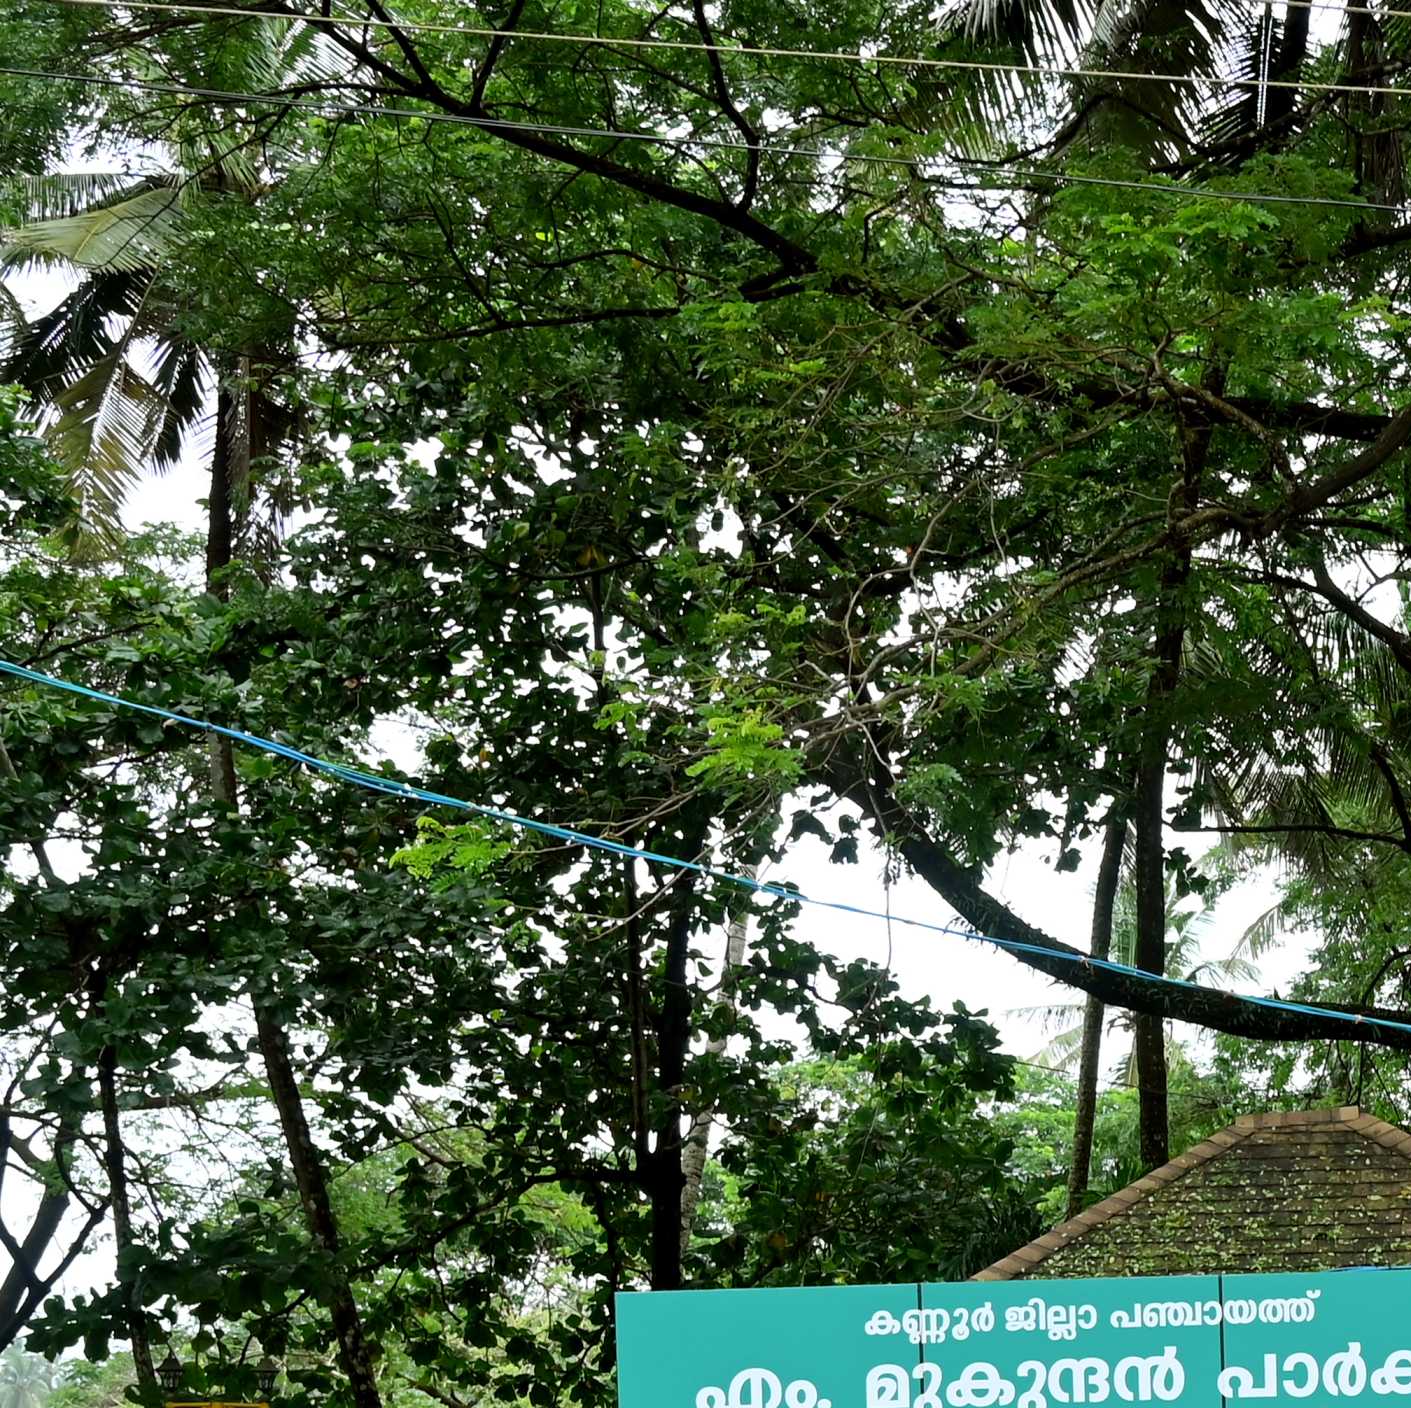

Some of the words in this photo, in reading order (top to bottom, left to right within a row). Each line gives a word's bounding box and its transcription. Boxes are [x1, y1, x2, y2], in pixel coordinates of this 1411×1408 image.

[864, 1302, 996, 1344] കണ്ണൂർ
[1005, 1298, 1098, 1341] ജില്ലാ
[1109, 1289, 1322, 1328] പഞ്ചായത്ത്
